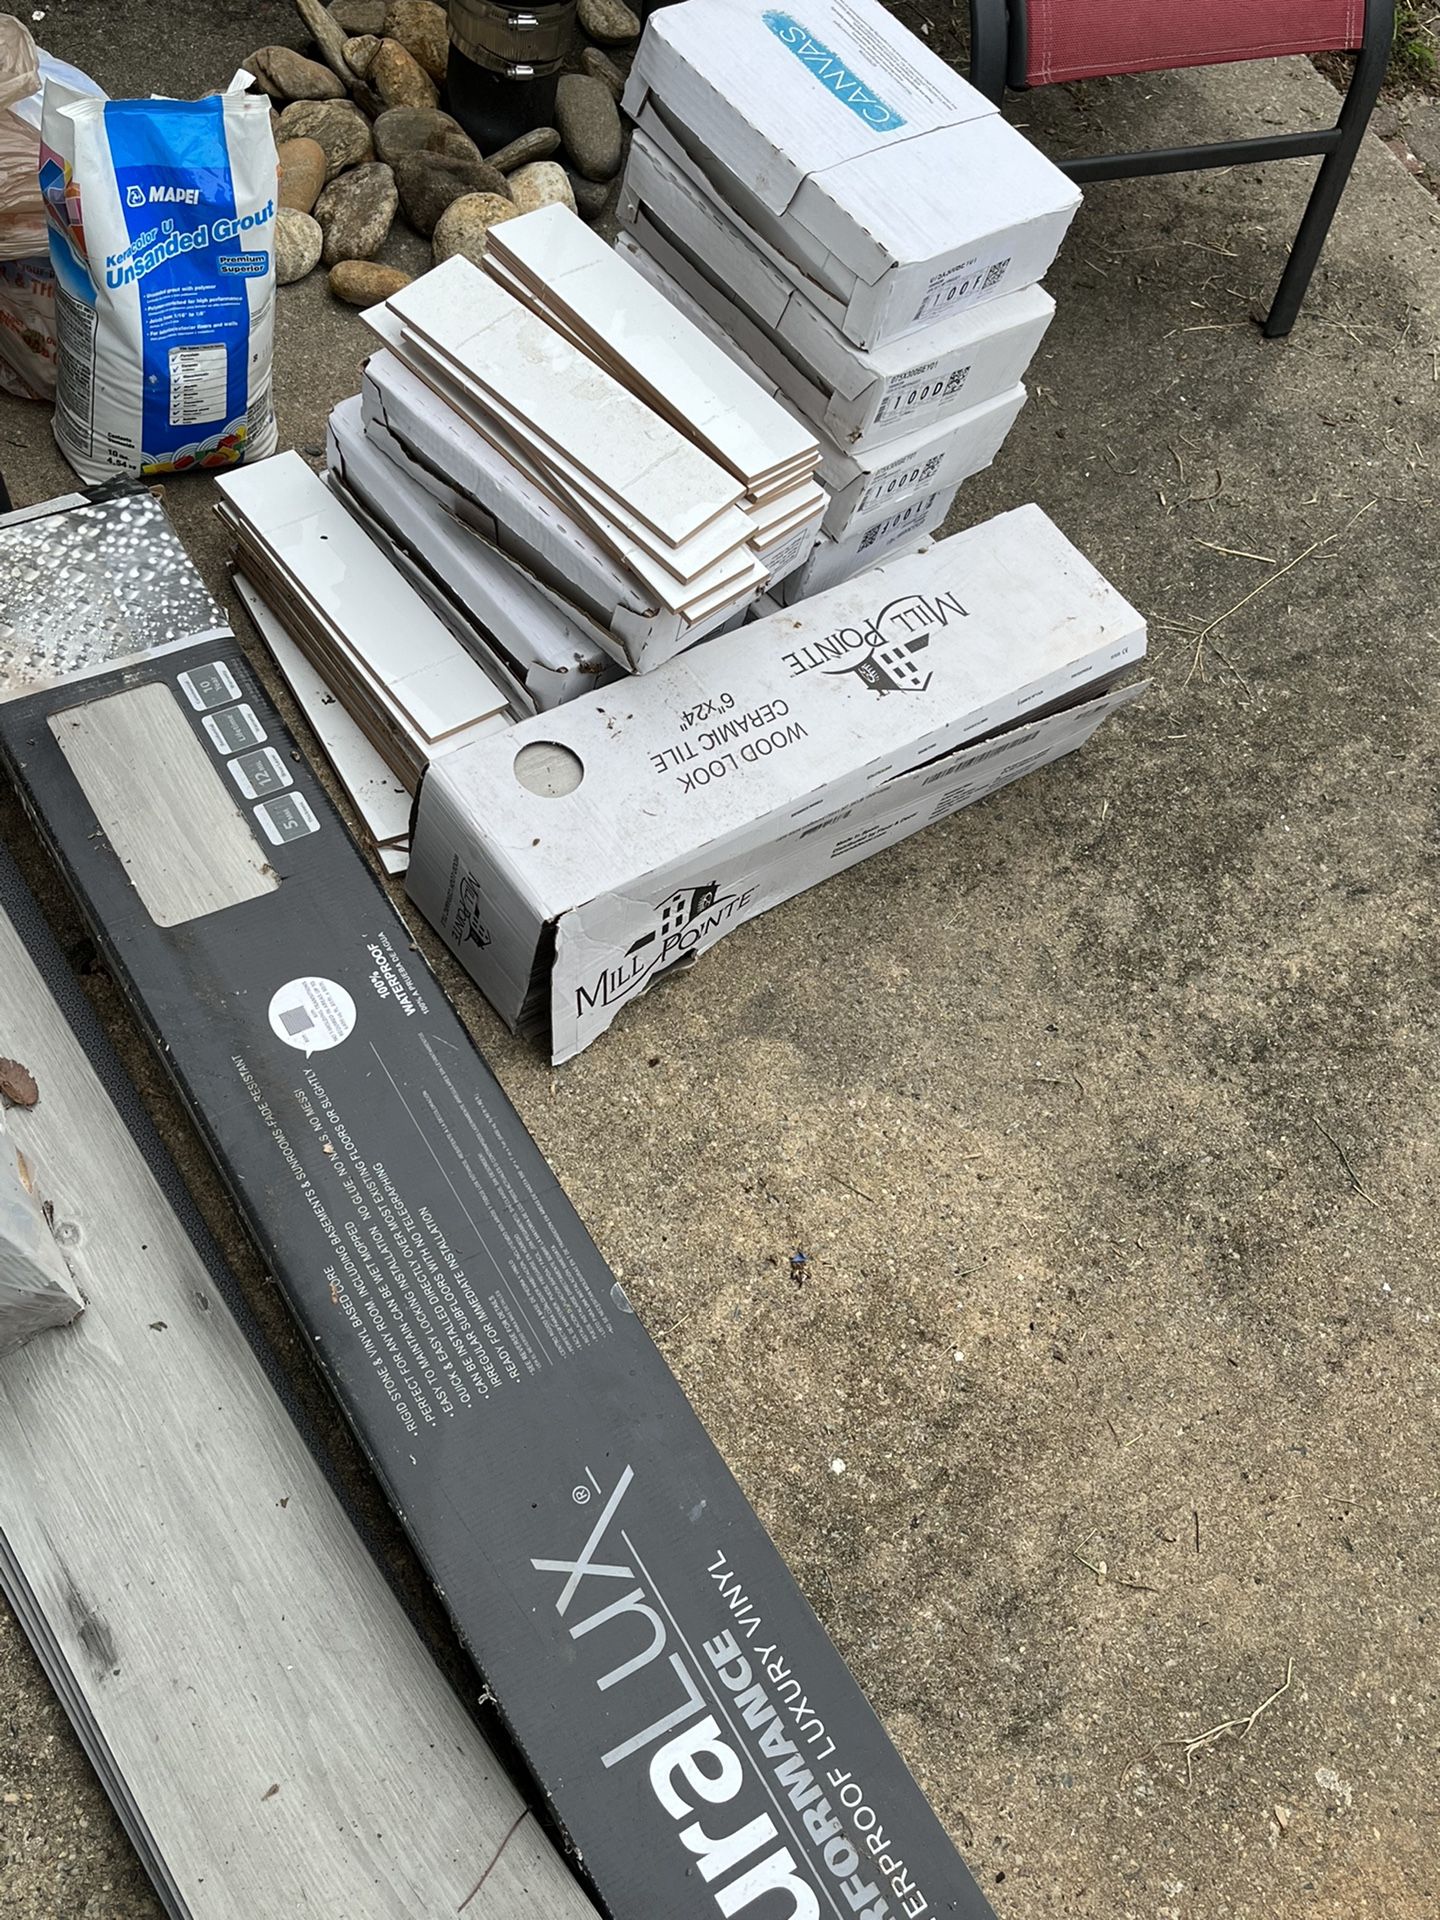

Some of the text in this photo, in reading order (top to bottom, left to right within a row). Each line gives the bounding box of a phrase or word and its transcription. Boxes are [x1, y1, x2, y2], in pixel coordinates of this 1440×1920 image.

[779, 26, 890, 124] CANVAS
[149, 186, 199, 205] MAPEI
[106, 219, 174, 268] Keracolor U
[106, 200, 274, 289] Unsanded Grout
[220, 256, 264, 264] Premium
[221, 265, 264, 273] Superior
[781, 591, 970, 677] MILL POINTE
[199, 680, 213, 693] 10
[210, 676, 222, 691] Year
[226, 714, 246, 742] Lifetime
[650, 698, 790, 774] CERAMIC TILE
[676, 722, 808, 794] WOOD LOOK
[377, 931, 393, 951] AGUA
[388, 951, 399, 962] DE
[575, 894, 752, 1018] MILL POINTE
[366, 943, 415, 1016] WATERPROOF
[368, 970, 390, 998] 100%
[395, 961, 415, 991] PRUEBA
[415, 995, 429, 1014] 100%
[231, 1055, 260, 1102] RESISTANT
[293, 1088, 314, 1116] MESS!
[308, 1116, 323, 1131] NO
[333, 1161, 347, 1176] NO
[300, 1180, 311, 1188] &
[342, 1175, 362, 1204] GLUE,
[304, 1188, 341, 1245] BASEMENTS
[357, 1204, 371, 1220] NO
[303, 1068, 488, 1394] CAN BE INSTALLED DIRECTLY OVER MOST EXISTING FLOORS OR SLIGHTLY
[344, 1221, 371, 1261] MOPPED
[335, 1245, 368, 1297] INCLUDING
[365, 1262, 383, 1284] WET
[372, 1162, 502, 1387] IRREGULAR SUBFLOORS WITH NO TELEGRAPHING
[377, 1283, 392, 1299] BE
[418, 1206, 519, 1378] READY FOR IMMEDIATE INSTALLATION
[364, 1296, 387, 1331] ROOM,
[403, 1290, 433, 1334] LOCKING
[487, 1294, 505, 1319] DETAILS
[501, 1318, 512, 1333] FOR
[323, 1264, 417, 1432] RIGID STONE & VINYL BASED CORE
[380, 1332, 398, 1351] ANY
[427, 1335, 448, 1362] EASY
[508, 1332, 527, 1360] REVERSE
[392, 1351, 410, 1375] FOR
[423, 1368, 437, 1385] TO
[442, 1361, 453, 1370] &
[403, 1376, 435, 1422] PERFECT
[432, 1385, 453, 1413] EASY
[447, 1370, 470, 1403] QUICK
[706, 1549, 932, 1920] ERPROOF LUXURY VINYL
